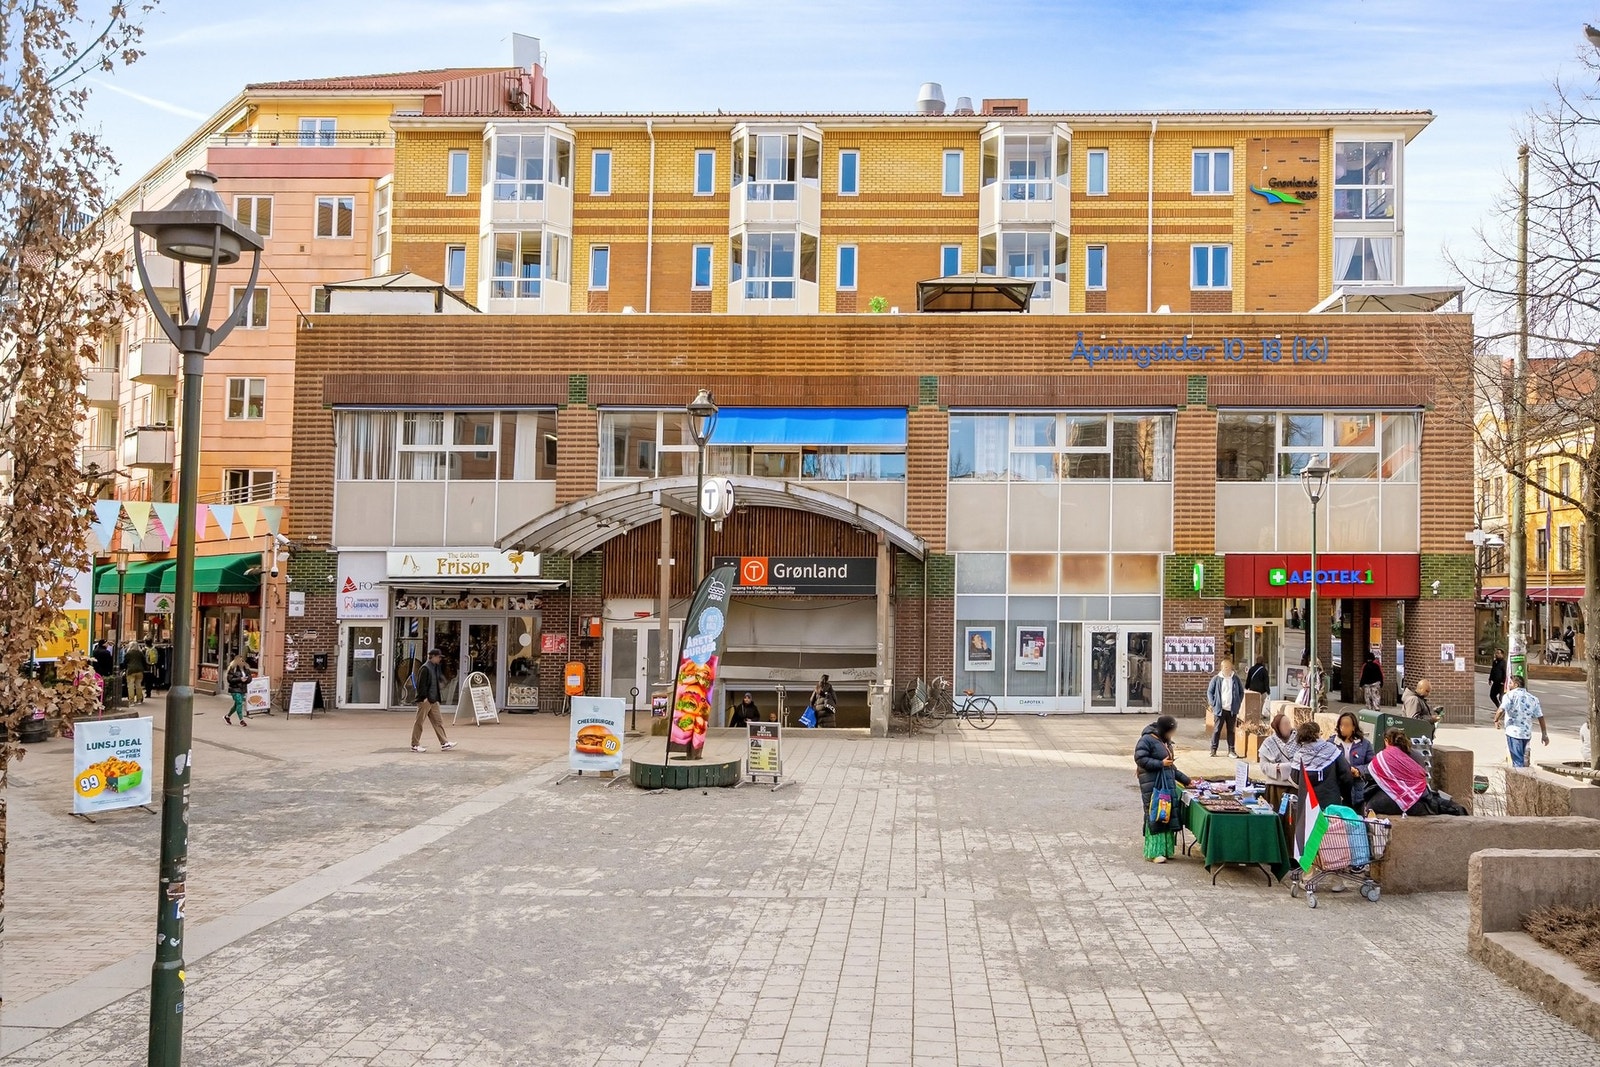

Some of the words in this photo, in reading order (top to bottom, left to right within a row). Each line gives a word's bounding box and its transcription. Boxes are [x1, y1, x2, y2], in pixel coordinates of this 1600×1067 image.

[1069, 331, 1216, 368] Åpningstider:
[1222, 338, 1245, 362] 10
[1260, 338, 1283, 362] 18
[1291, 335, 1329, 364] (16)
[704, 489, 717, 510] T
[436, 558, 490, 575] Frisør
[773, 563, 848, 579] Grønland
[1289, 570, 1362, 584] APOTEK
[1364, 570, 1375, 584] 1
[358, 636, 372, 645] FO
[686, 634, 714, 649] ÅRETS
[683, 641, 717, 659] BURGER
[577, 717, 615, 727] CHEESEBURGER
[86, 741, 117, 751] LUNSJ
[119, 738, 142, 748] DEAL
[606, 740, 617, 750] 80
[80, 774, 100, 791] 99
